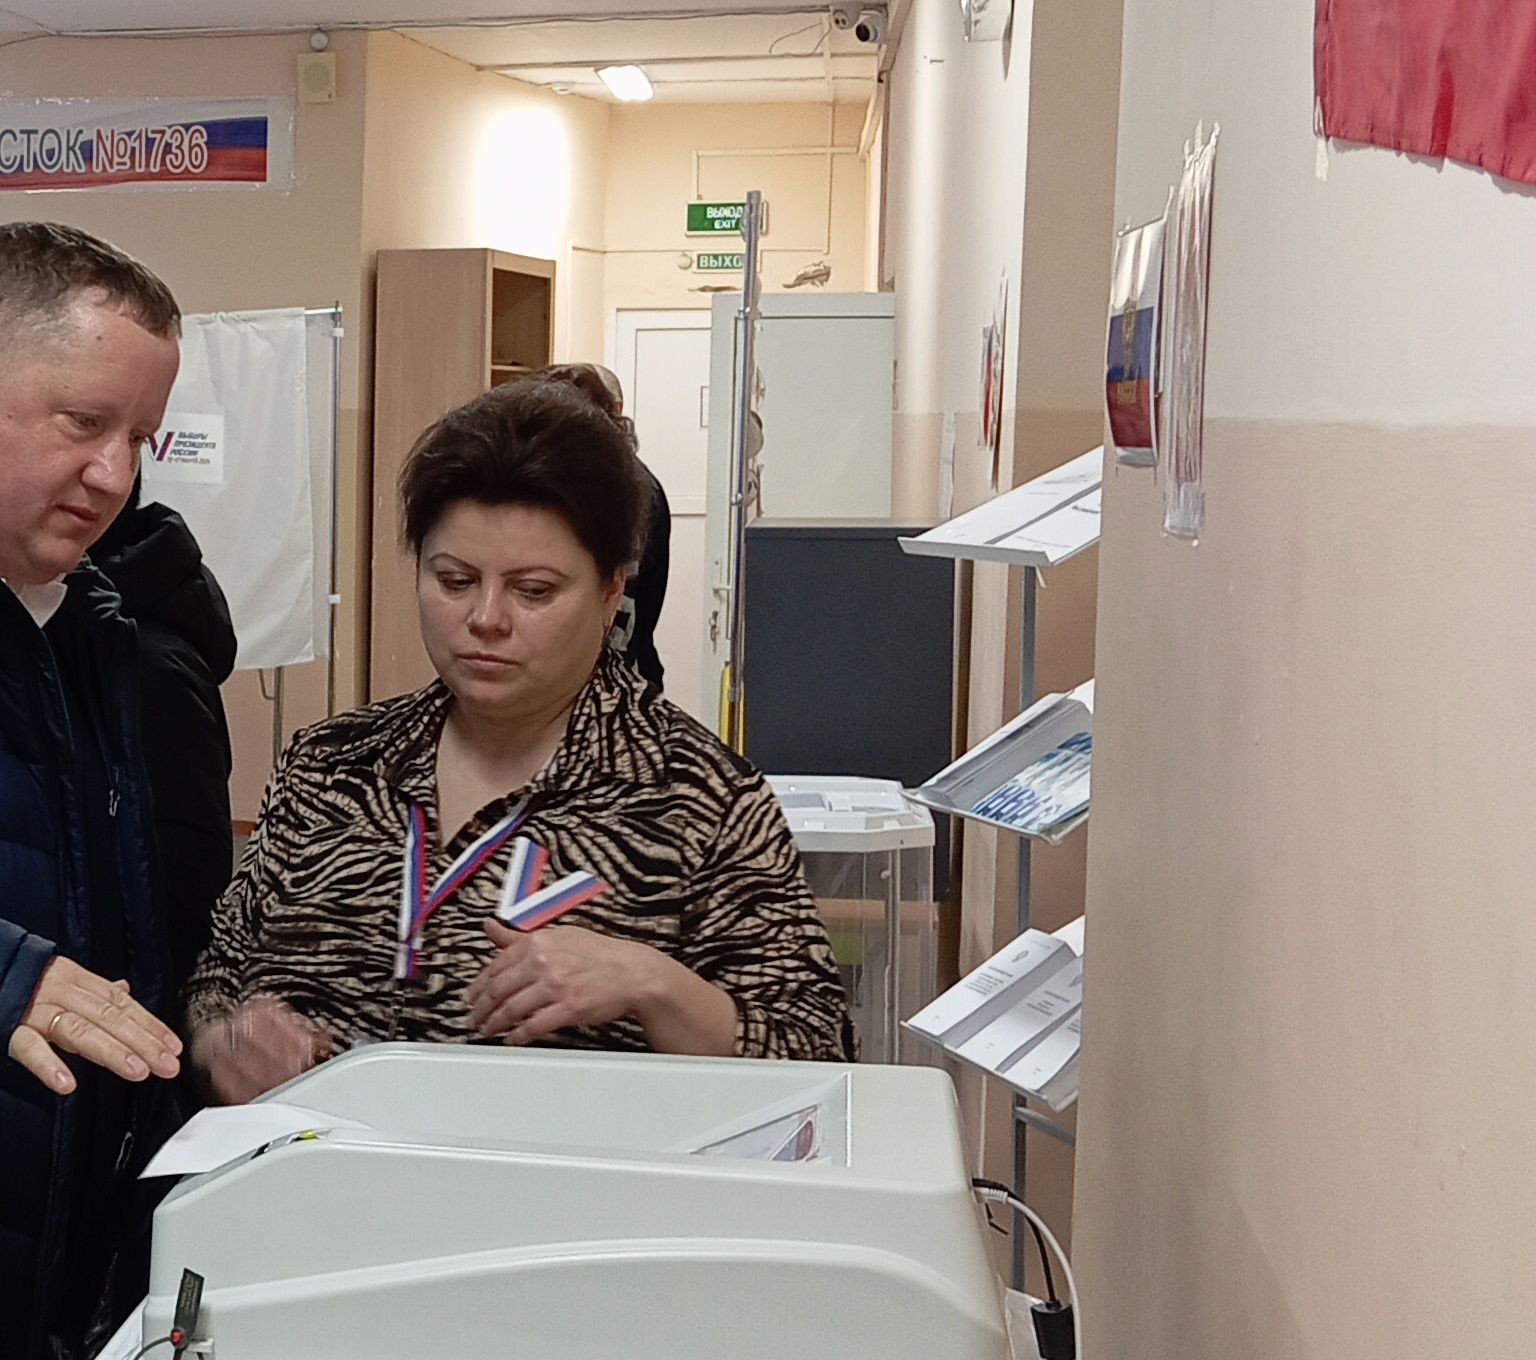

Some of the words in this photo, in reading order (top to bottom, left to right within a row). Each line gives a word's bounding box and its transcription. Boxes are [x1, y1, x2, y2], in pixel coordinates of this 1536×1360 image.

[94, 126, 208, 171] №1736
[714, 219, 737, 229] EXIT
[699, 254, 744, 268] ВЫХО
